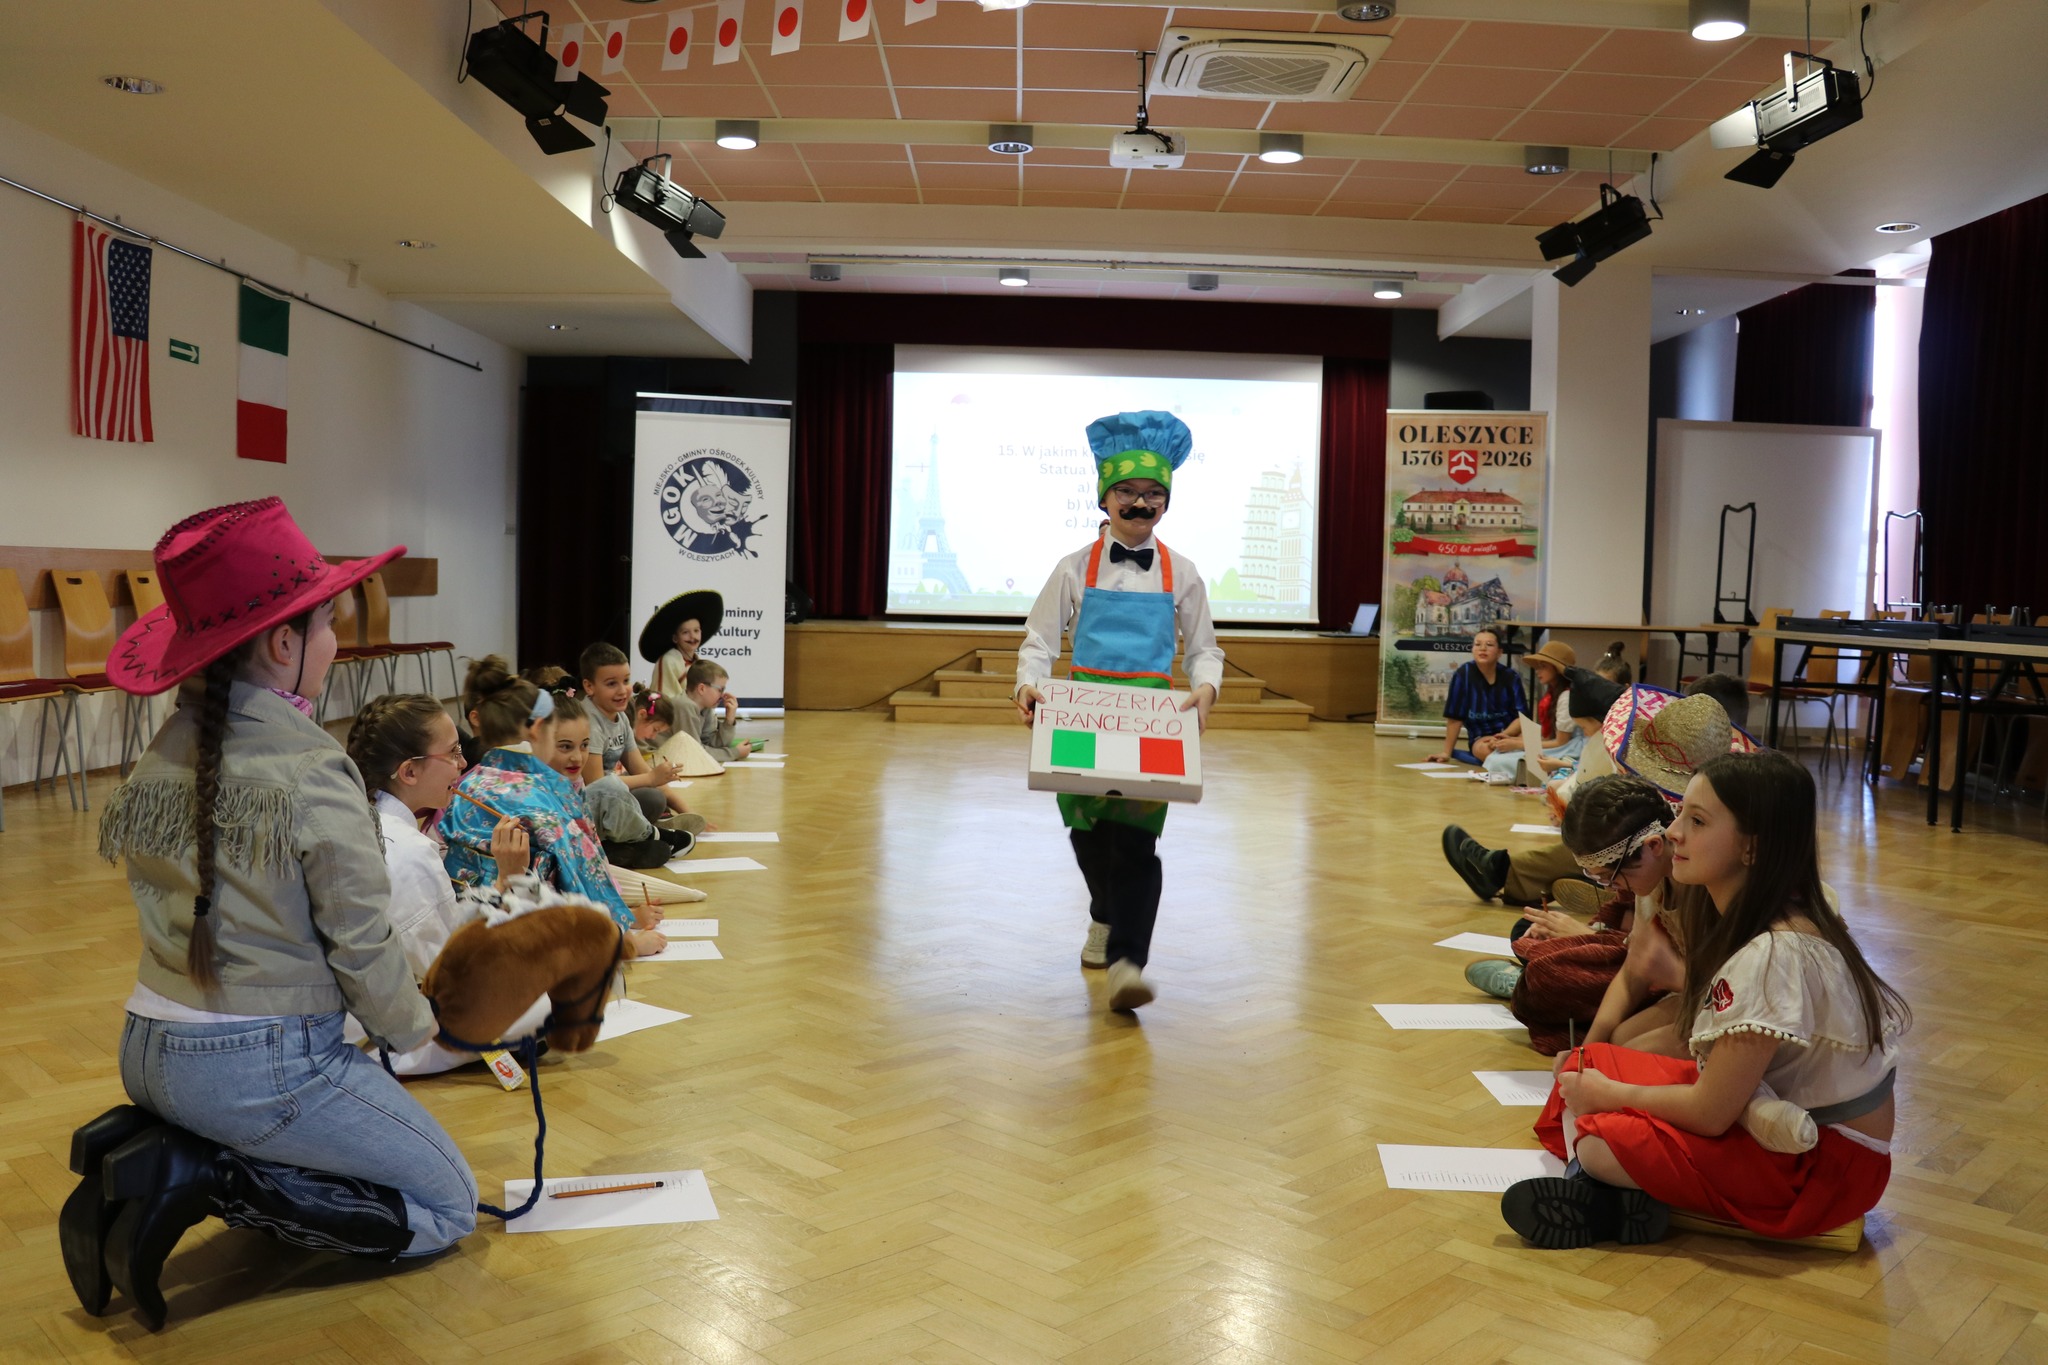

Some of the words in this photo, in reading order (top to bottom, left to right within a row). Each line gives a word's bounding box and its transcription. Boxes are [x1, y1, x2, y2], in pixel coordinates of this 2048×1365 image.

[1399, 425, 1534, 444] OLESZYCE
[998, 445, 1018, 456] 15.
[1022, 446, 1035, 456] W
[1039, 446, 1077, 460] jakim
[1401, 450, 1443, 466] 1576
[1482, 450, 1532, 467] 2026
[653, 465, 674, 496] MIEJSKO
[677, 448, 708, 463] GMINNY
[709, 448, 746, 468] OŚRODEK
[744, 466, 764, 500] KULTURY
[1040, 463, 1086, 475] Statua
[1077, 481, 1090, 494] a)
[662, 466, 698, 548] MGOK
[1067, 499, 1080, 511] b)
[1065, 516, 1077, 528] c)
[1437, 543, 1458, 554] 450
[686, 550, 735, 562] OLESZYCACH
[724, 607, 763, 620] minny
[695, 646, 751, 658] szycach
[1433, 643, 1473, 651] OLESZYC
[1042, 683, 1178, 714] PIZZERIA
[1039, 708, 1183, 736] FRANCESCO
